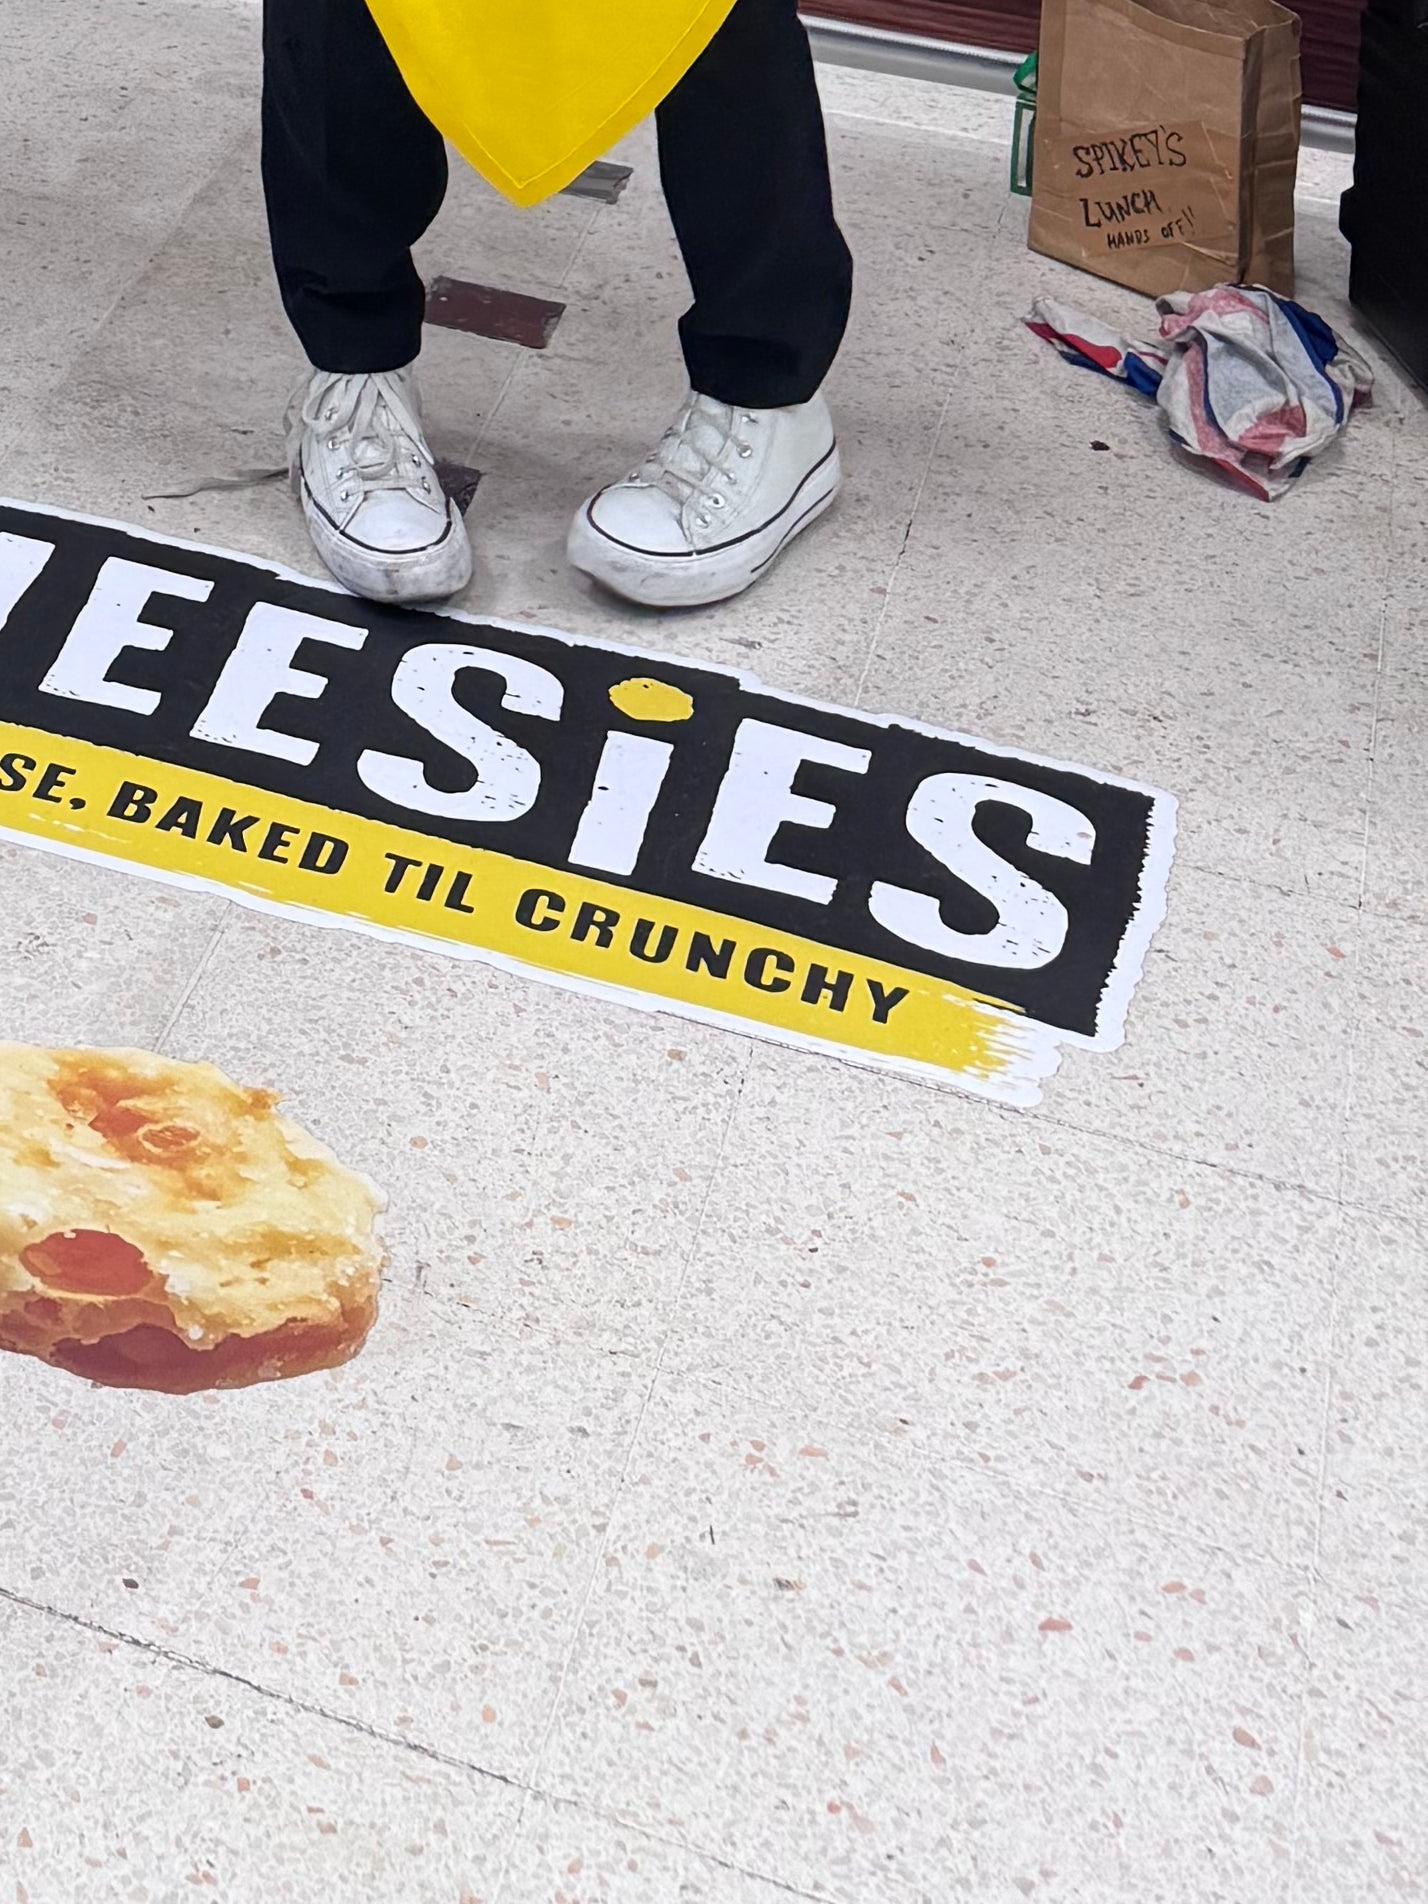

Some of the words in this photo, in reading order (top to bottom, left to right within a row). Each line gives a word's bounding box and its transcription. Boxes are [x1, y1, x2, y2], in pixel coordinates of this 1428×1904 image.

[1073, 125, 1187, 179] SPIKEY'S
[1079, 189, 1163, 228] LUNCH
[1107, 228, 1150, 249] HANDS
[106, 779, 349, 876] BAKED
[384, 852, 477, 914] TIL
[513, 886, 912, 1026] CRUNCHY
